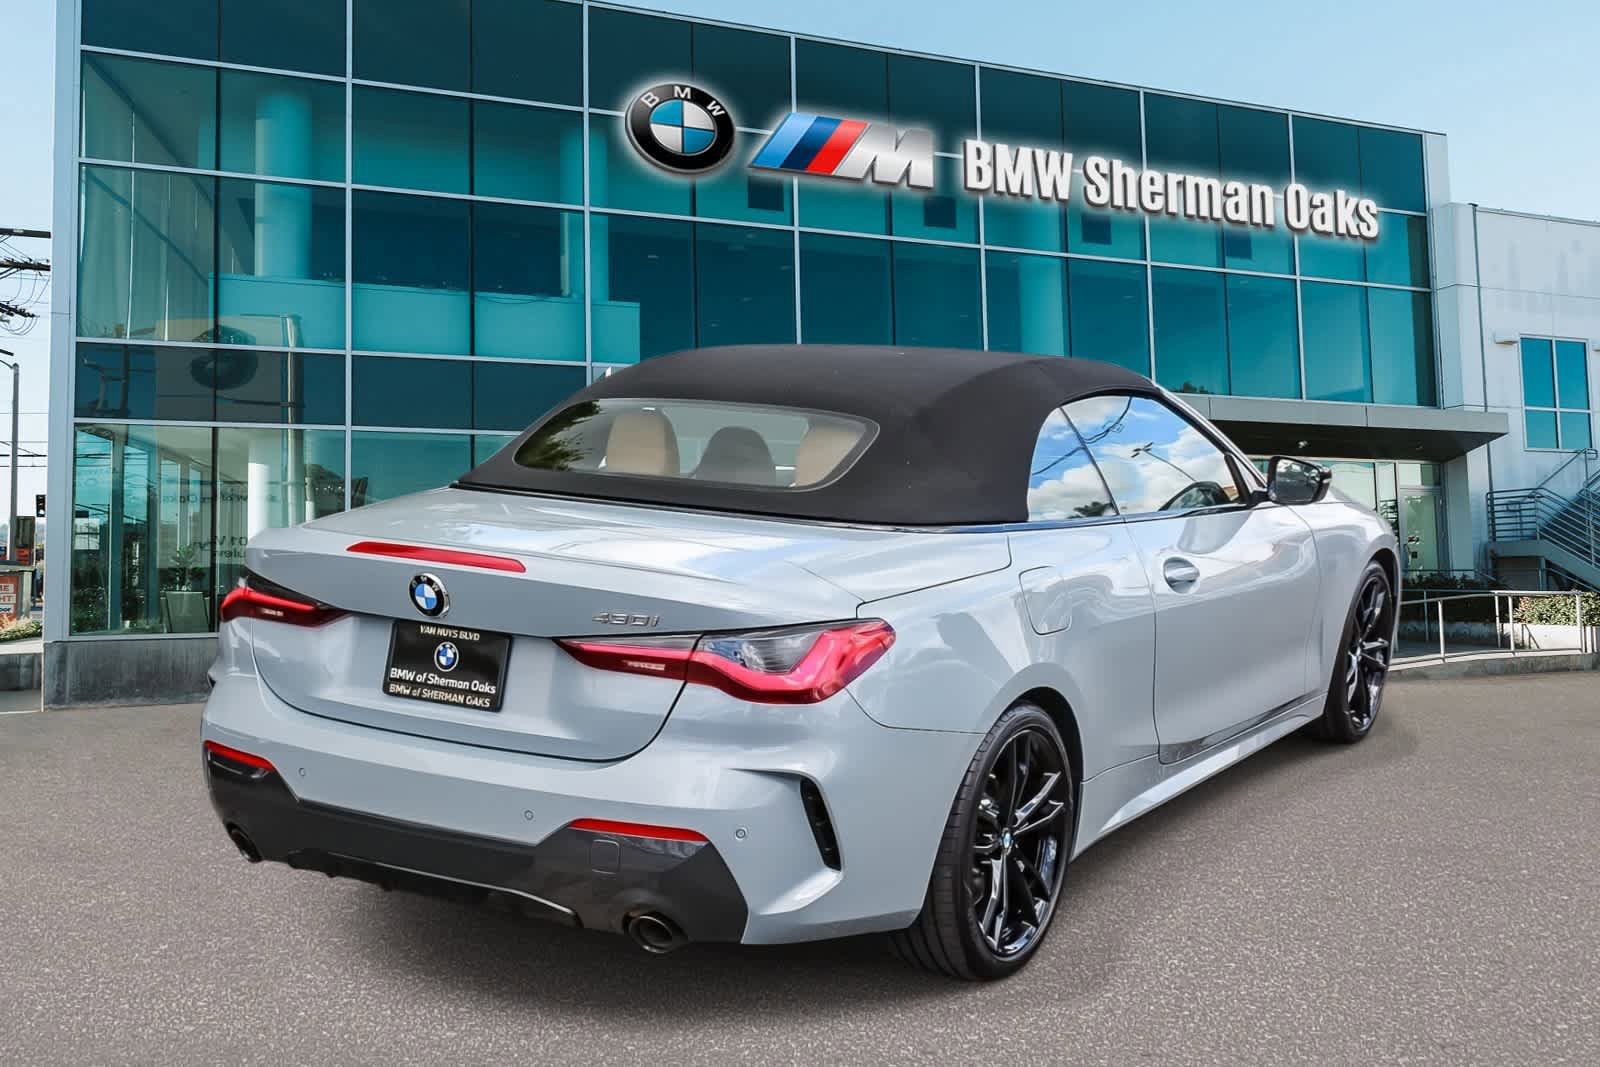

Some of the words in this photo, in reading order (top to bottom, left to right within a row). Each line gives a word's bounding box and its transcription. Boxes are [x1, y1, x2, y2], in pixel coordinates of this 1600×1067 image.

[640, 85, 726, 117] BMW
[832, 122, 935, 189] M
[963, 139, 1073, 200] BMW
[1084, 155, 1275, 226] Sherman
[1283, 183, 1380, 240] Oaks
[420, 624, 436, 635] VAN
[437, 627, 458, 638] NUYS
[459, 630, 480, 640] BLVD
[592, 612, 659, 627] 430i
[390, 668, 416, 681] BMW
[416, 672, 427, 683] of
[427, 674, 469, 690] Sherman
[471, 680, 496, 694] Oaks
[389, 684, 411, 695] BMW
[412, 688, 421, 696] of
[422, 688, 465, 703] SHERMAN
[466, 696, 490, 708] OAKS
